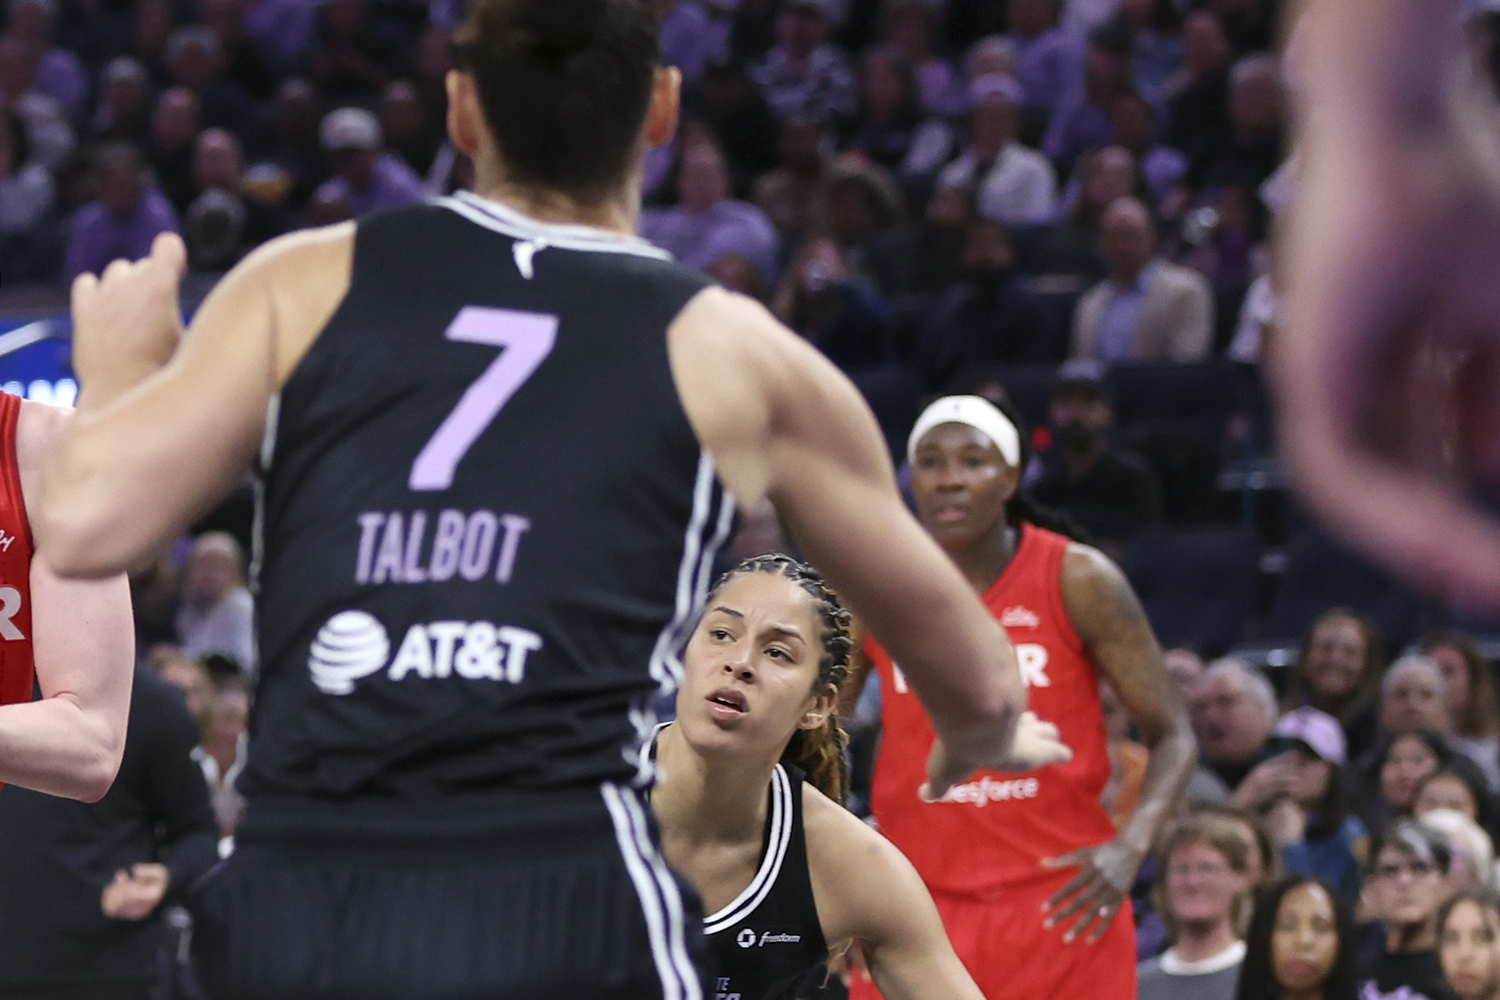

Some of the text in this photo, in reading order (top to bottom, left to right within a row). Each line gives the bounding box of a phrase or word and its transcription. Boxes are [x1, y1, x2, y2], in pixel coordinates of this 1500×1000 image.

[407, 305, 558, 490] 7
[355, 508, 531, 585] TALBOT
[387, 619, 543, 686] AT&T
